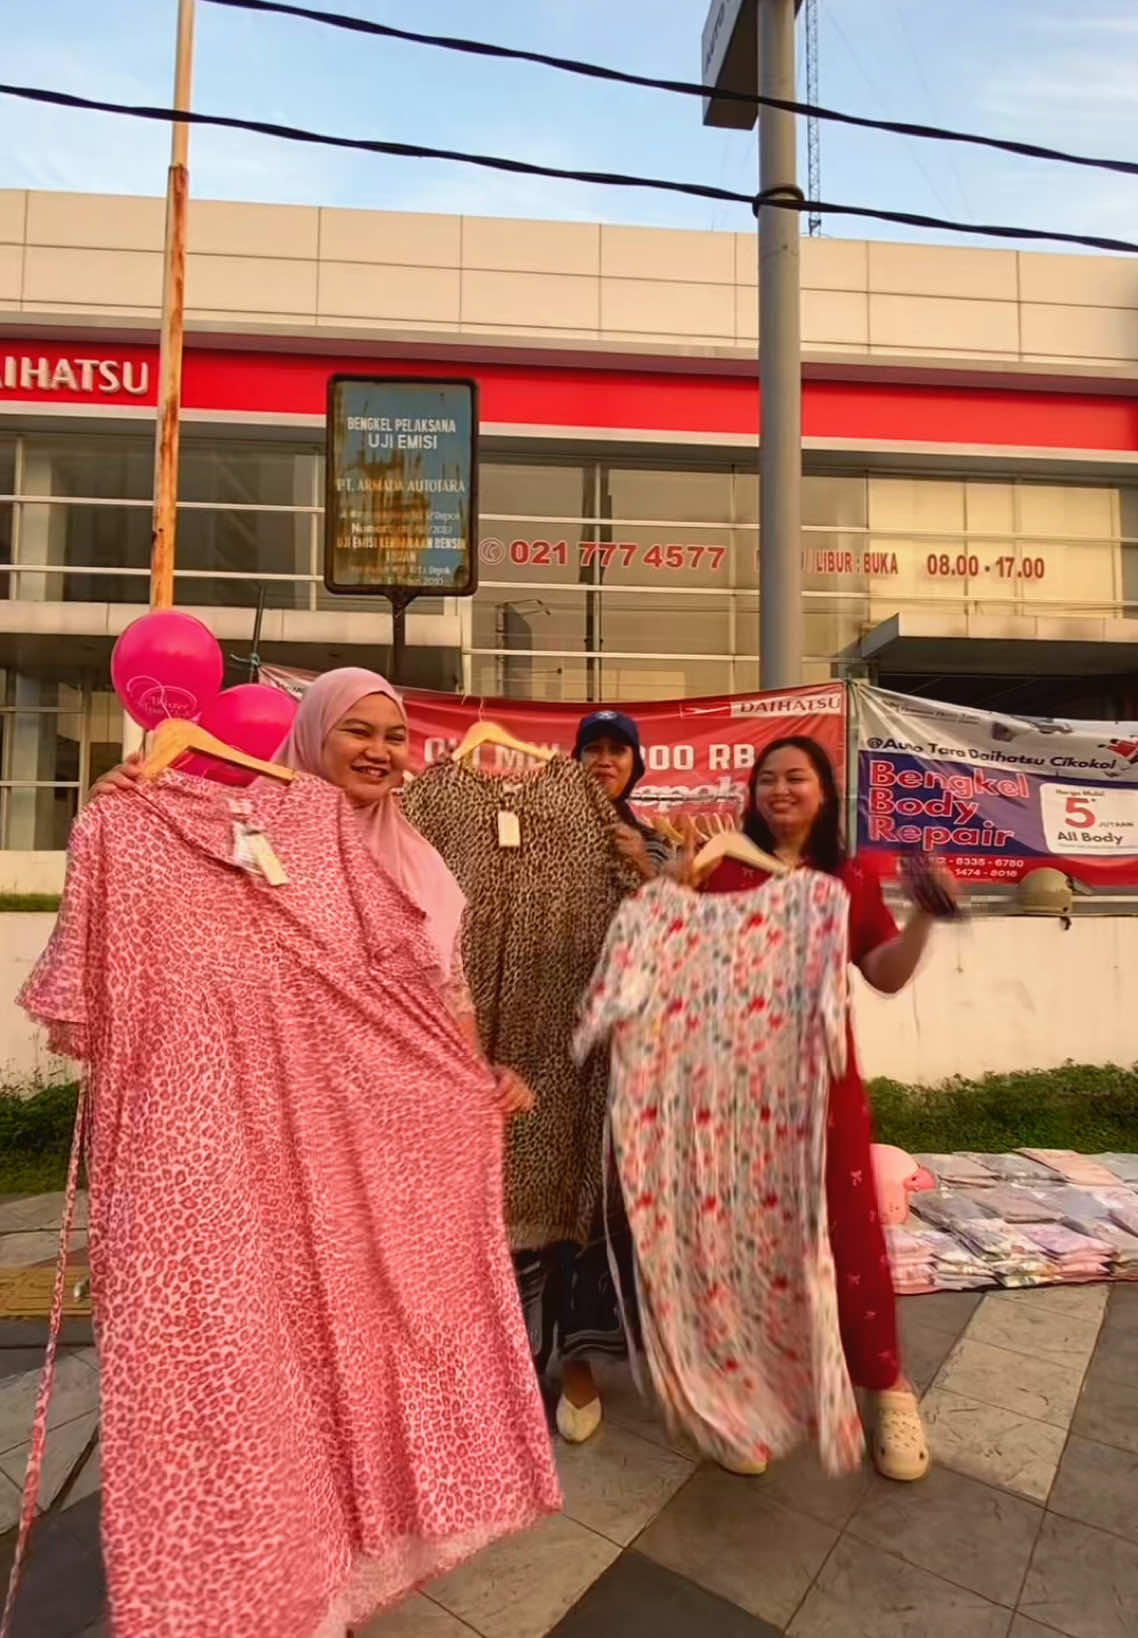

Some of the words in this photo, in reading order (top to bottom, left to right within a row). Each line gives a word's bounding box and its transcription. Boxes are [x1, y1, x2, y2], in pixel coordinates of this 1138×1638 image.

[0, 356, 149, 395] IHATSU
[395, 418, 456, 433] PELAKSANA
[368, 434, 393, 448] UJI
[397, 435, 438, 449] EMISI
[510, 541, 567, 565] 021
[578, 543, 639, 567] 777
[644, 545, 726, 569] 4577
[863, 552, 898, 575] BUKA
[926, 554, 979, 576] 08.00
[996, 556, 1045, 578] 17.00
[740, 697, 841, 713] DAIHATSU
[630, 743, 694, 770] 00
[709, 743, 756, 770] RB
[968, 748, 1045, 766] Daihatsu
[1049, 756, 1117, 770] Cikokol
[868, 760, 1031, 799] Bengkel
[868, 786, 980, 825] Body
[1065, 797, 1096, 829] 5
[868, 814, 1016, 852] Repair
[1058, 831, 1078, 841] All
[1081, 832, 1123, 845] Body
